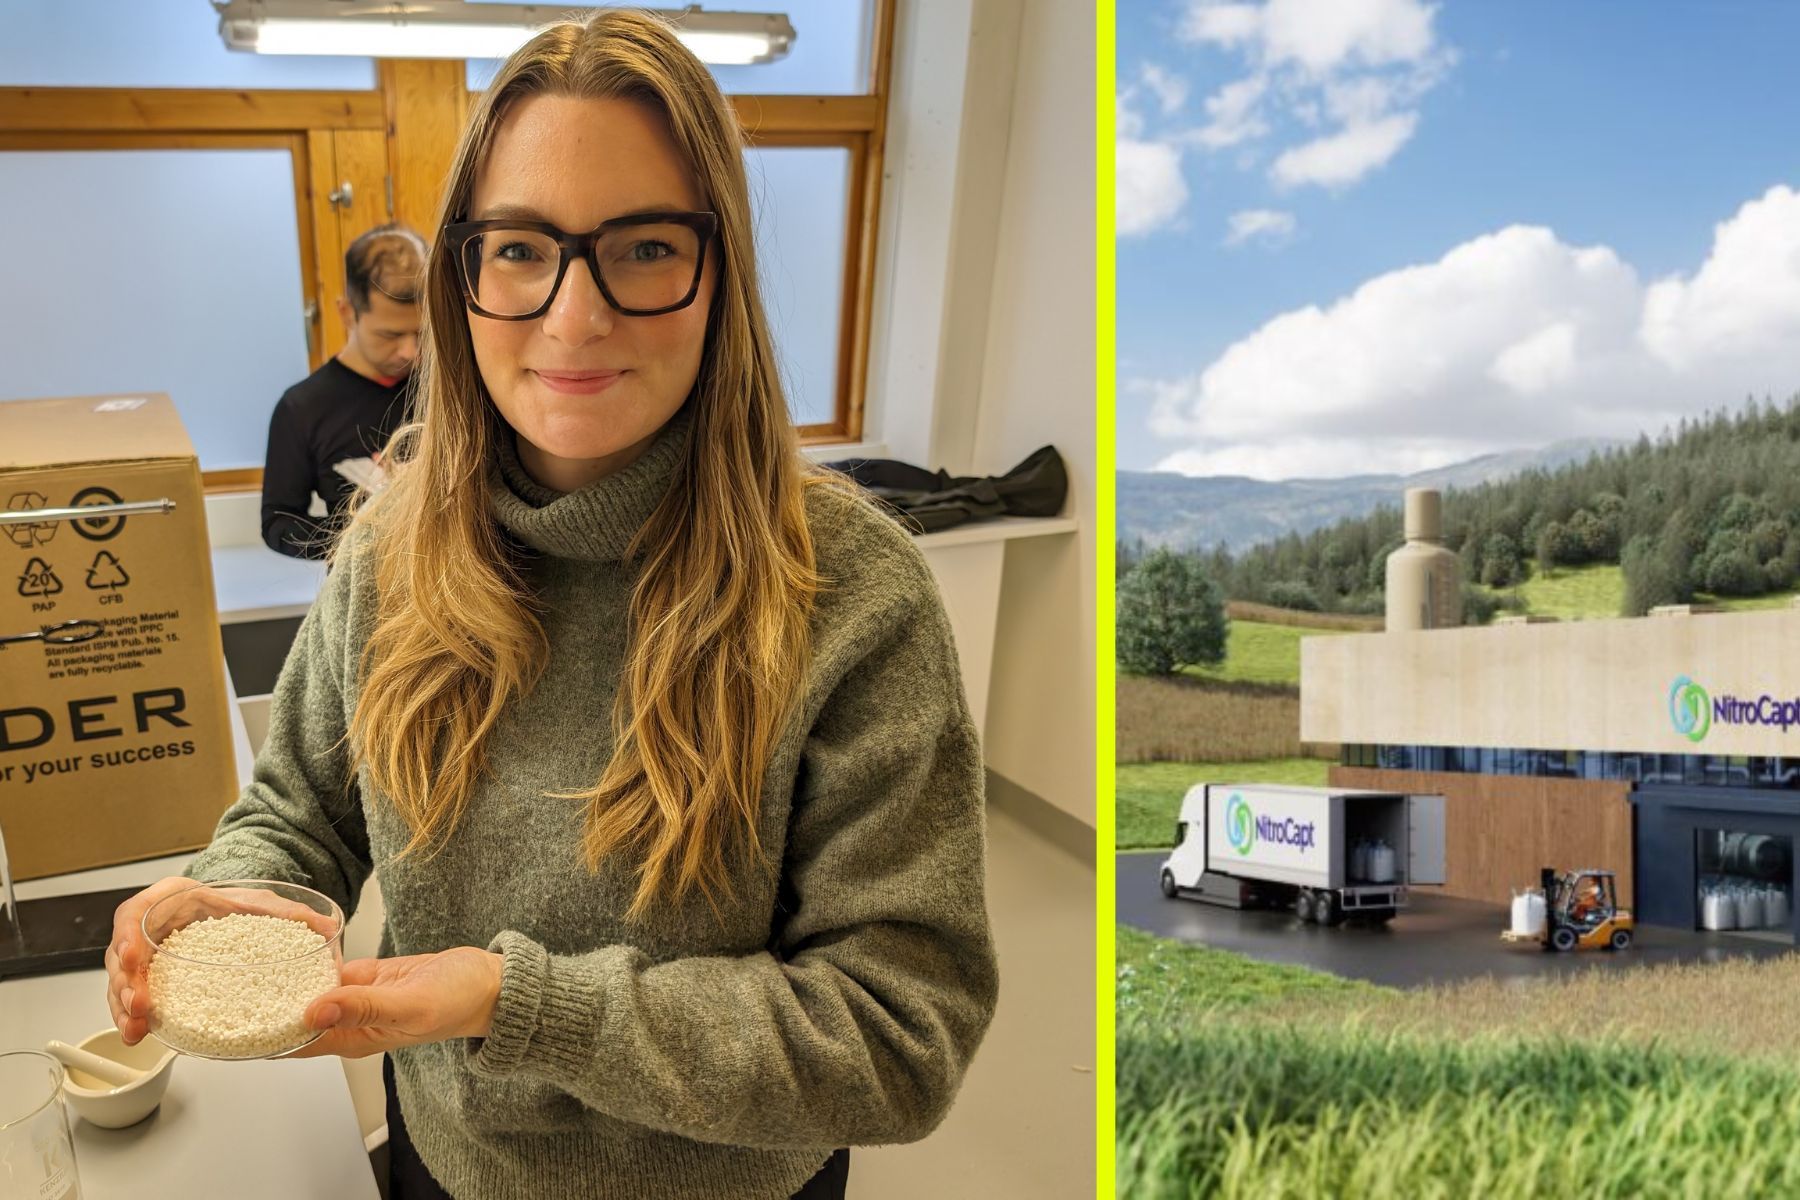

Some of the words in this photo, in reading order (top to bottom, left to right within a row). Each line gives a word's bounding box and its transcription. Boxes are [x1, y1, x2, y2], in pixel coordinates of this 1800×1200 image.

[29, 573, 49, 587] 20
[32, 601, 56, 613] PAP
[98, 594, 124, 605] CFB
[140, 609, 179, 622] Material
[116, 626, 138, 636] with
[139, 622, 164, 634] IPPC
[45, 643, 91, 656] Standard
[93, 639, 119, 651] ISPM
[121, 637, 145, 648] Pub.
[146, 635, 163, 645] No.
[47, 658, 61, 668] All
[63, 654, 115, 668] packaging
[117, 646, 162, 658] materials
[49, 671, 65, 679] are
[67, 667, 89, 677] fully
[92, 660, 145, 674] recyclable.
[0, 687, 192, 751] DER
[22, 754, 83, 784] your
[91, 740, 196, 769] success
[1256, 815, 1315, 854] NitroCapt
